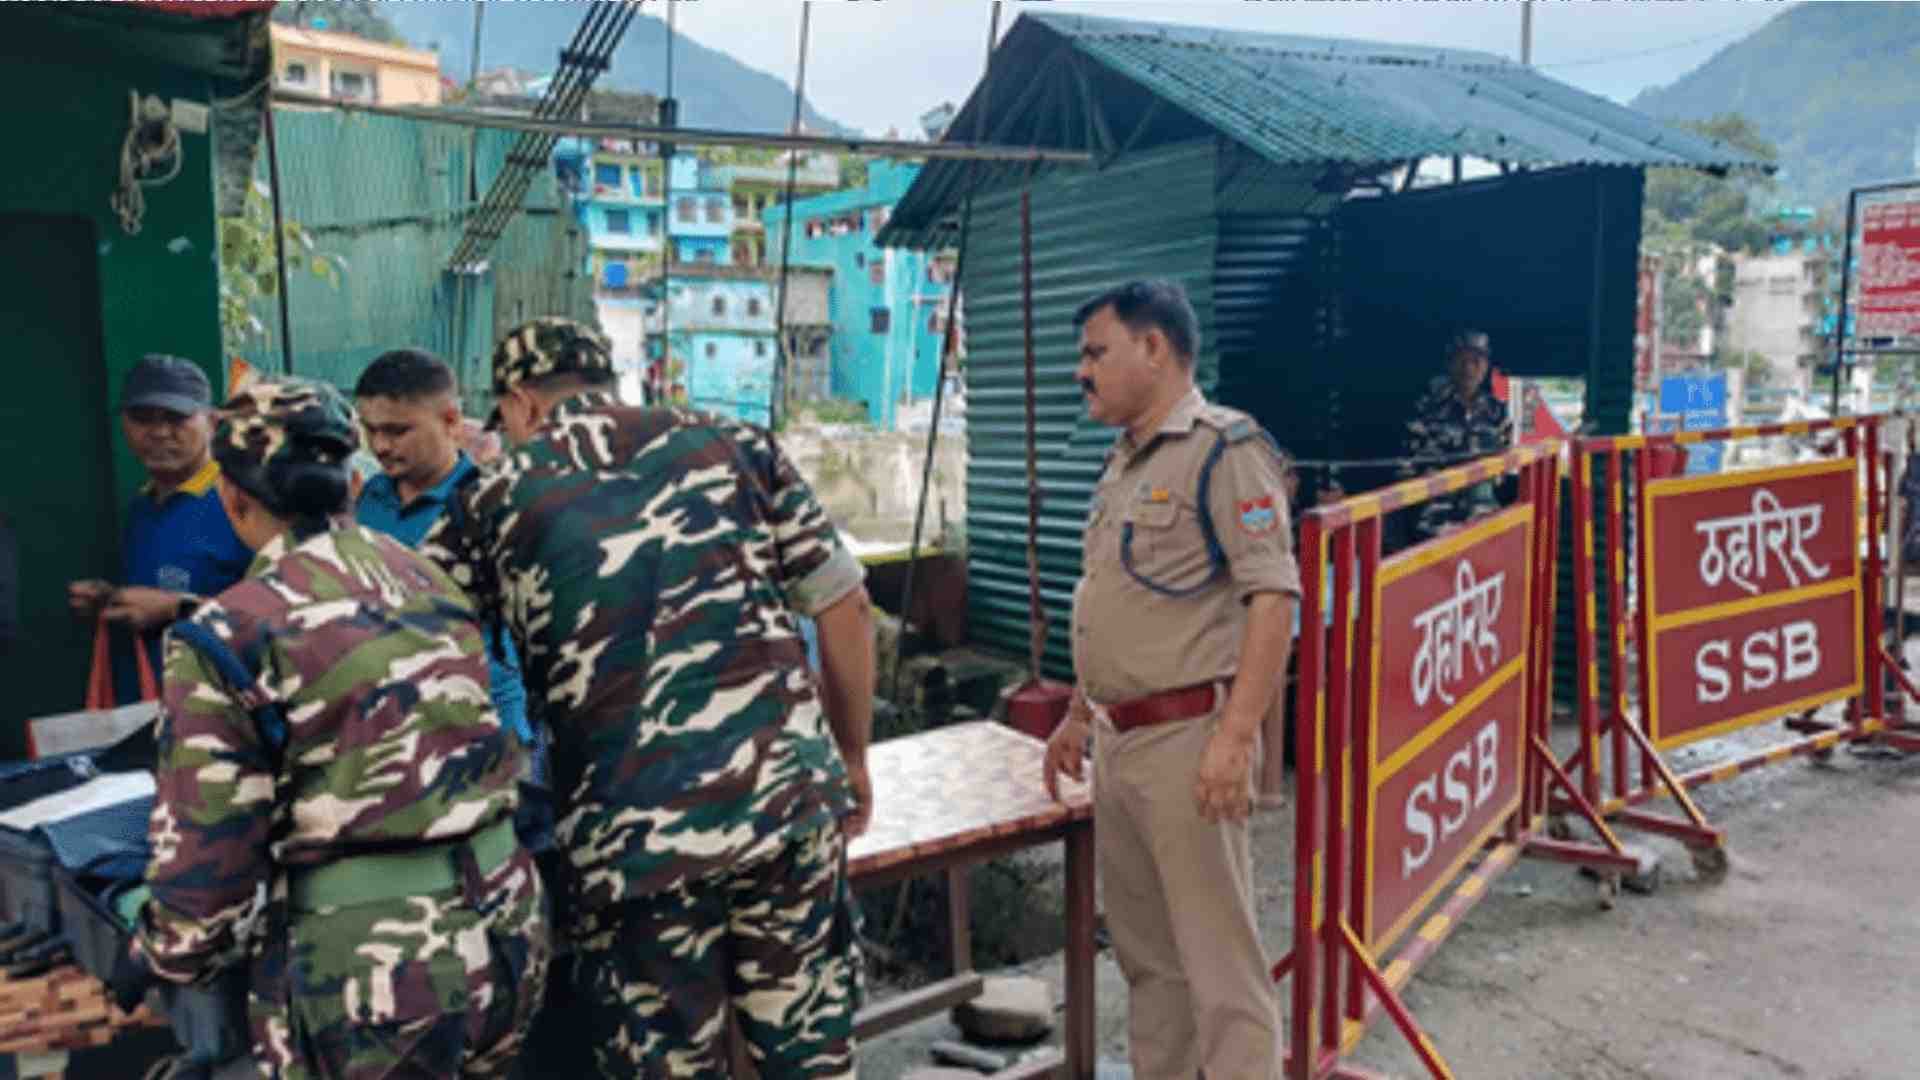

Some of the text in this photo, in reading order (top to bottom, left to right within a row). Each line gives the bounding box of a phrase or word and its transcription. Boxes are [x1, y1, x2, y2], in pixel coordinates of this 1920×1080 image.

[1695, 489, 1829, 594] ठहरिए
[1412, 560, 1505, 704] ठहरिए
[1696, 621, 1820, 702] SSB
[1403, 720, 1498, 877] SSB
